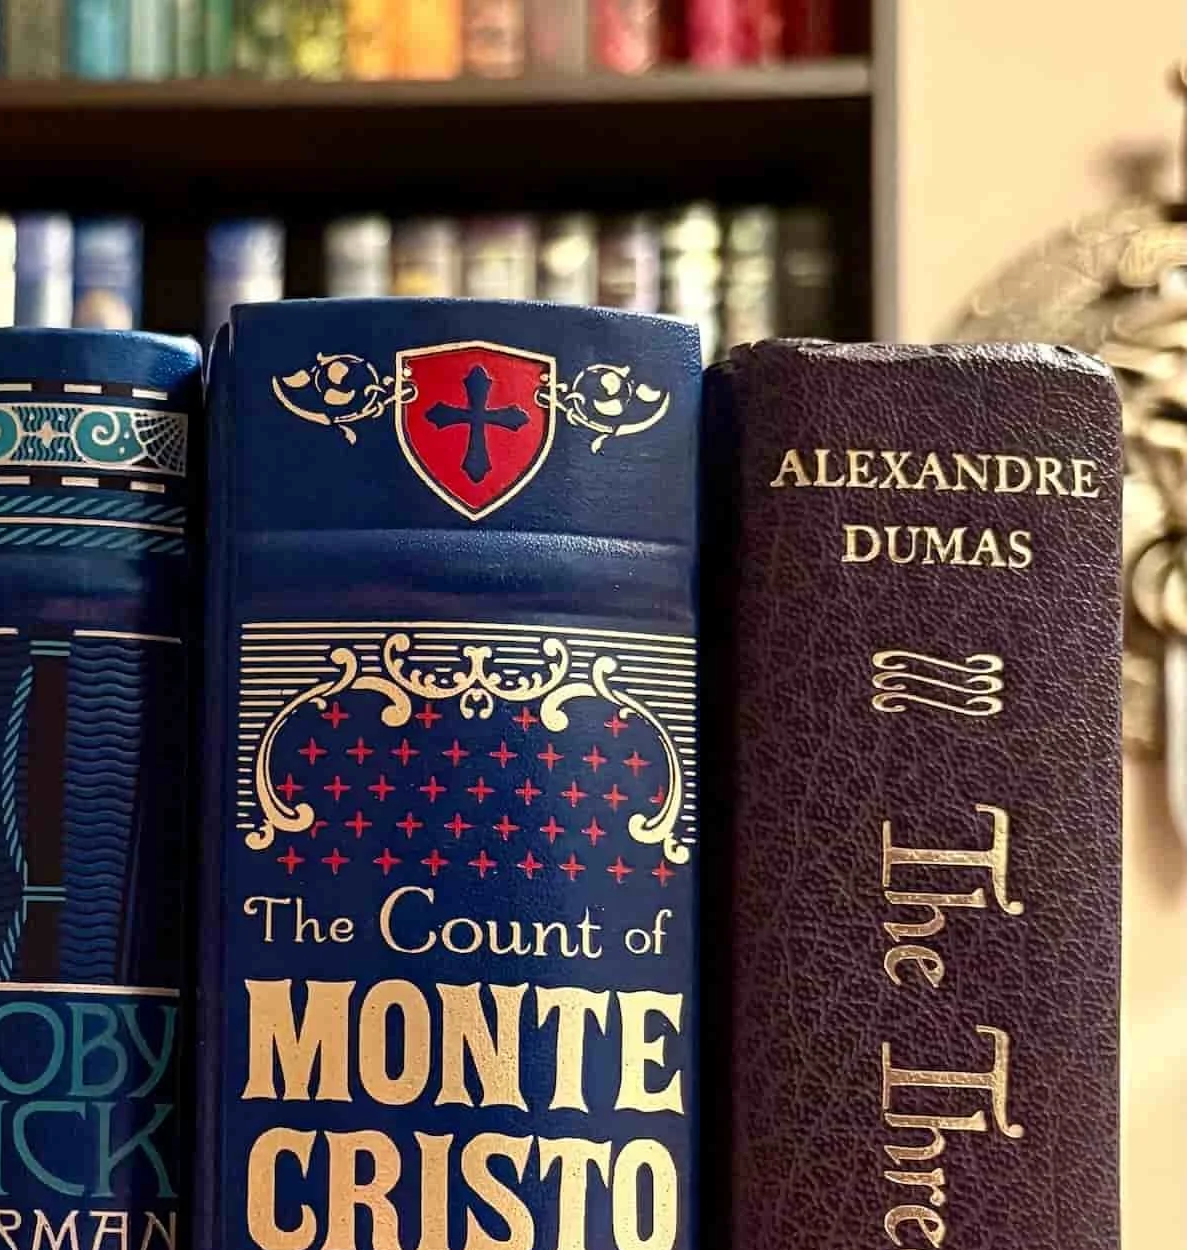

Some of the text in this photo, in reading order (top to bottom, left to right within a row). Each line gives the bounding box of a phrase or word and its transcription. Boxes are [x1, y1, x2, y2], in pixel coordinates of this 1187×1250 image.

[770, 449, 1100, 498] ALEXANDRE
[841, 525, 1033, 569] DUMAS
[243, 886, 673, 958] The Count of
[882, 803, 1024, 988] The
[241, 978, 684, 1114] MONTE
